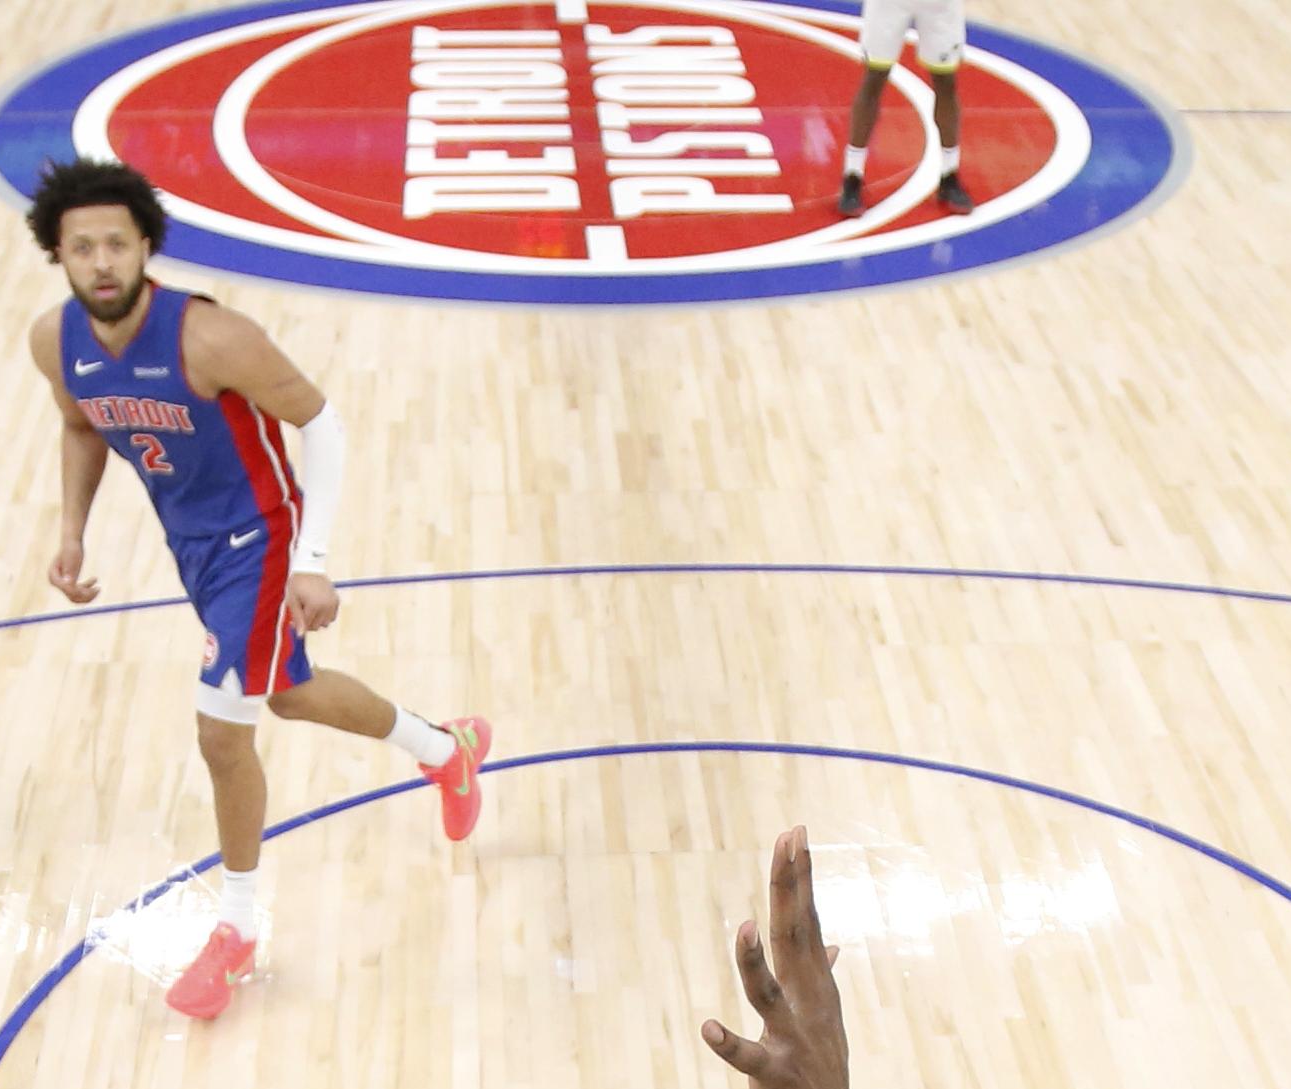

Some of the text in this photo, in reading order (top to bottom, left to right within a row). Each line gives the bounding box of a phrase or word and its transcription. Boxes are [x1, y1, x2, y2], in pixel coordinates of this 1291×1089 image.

[402, 25, 581, 220] DETROIT
[583, 23, 795, 219] PISTONS
[130, 433, 174, 475] 2
